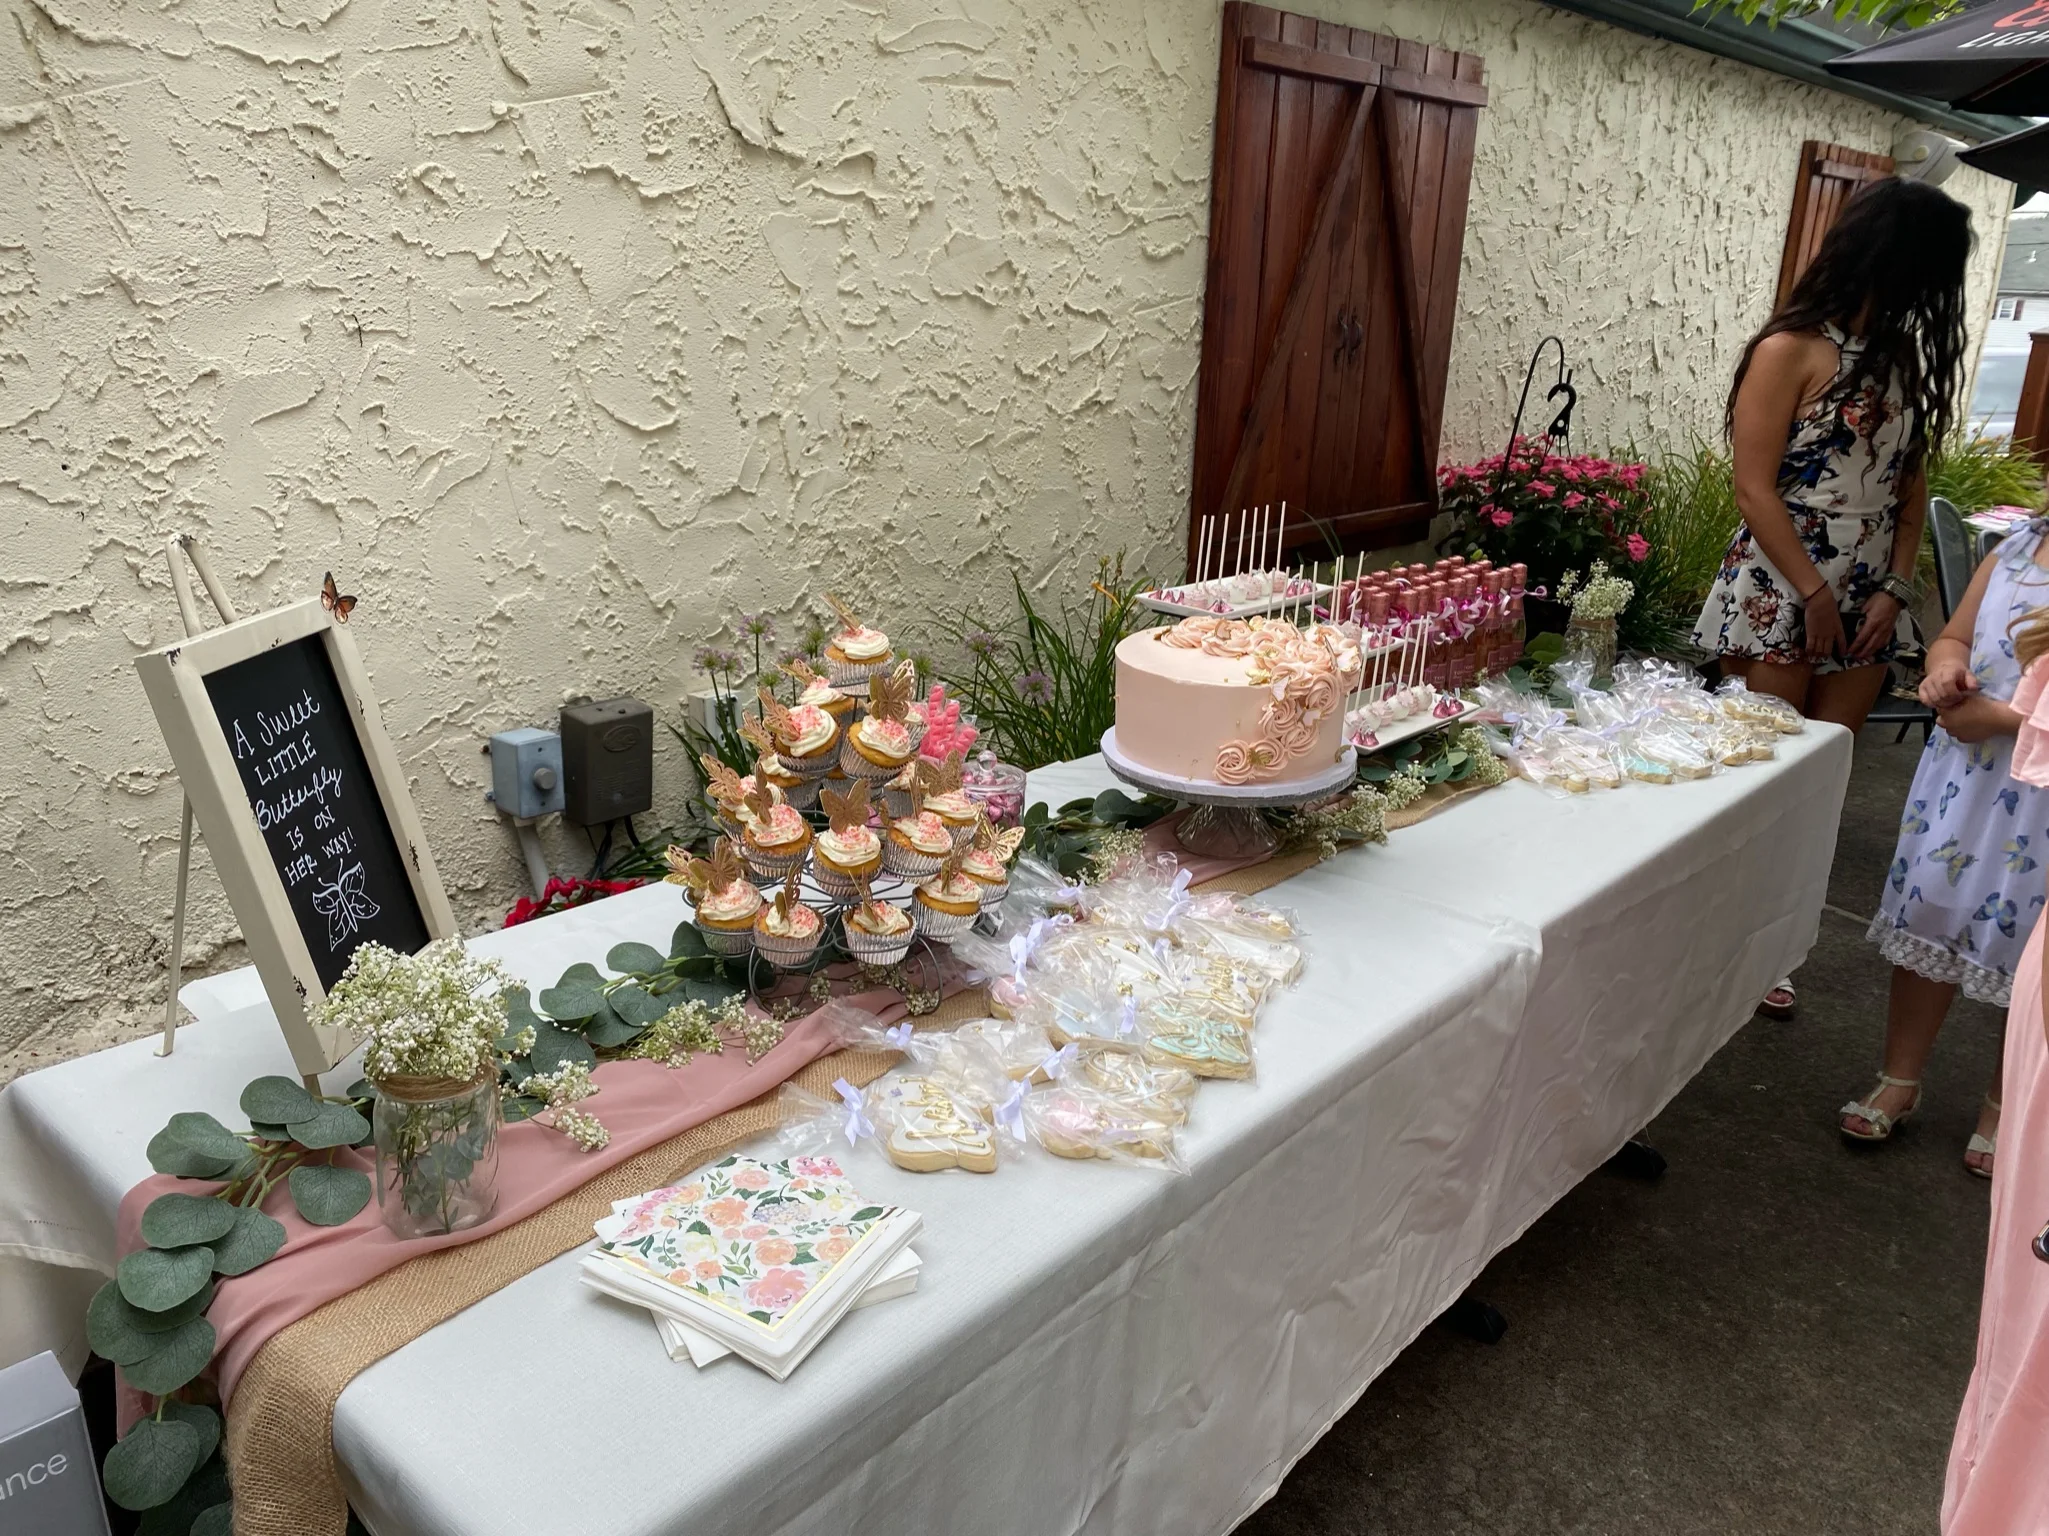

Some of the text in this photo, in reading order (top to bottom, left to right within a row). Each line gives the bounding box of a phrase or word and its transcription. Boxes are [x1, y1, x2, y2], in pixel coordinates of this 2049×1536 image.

[1957, 30, 2049, 48] LIGH
[233, 689, 320, 759] A Sweet
[254, 731, 318, 786] LITTLE
[255, 766, 342, 831] Butterfly
[284, 826, 357, 886] HER WAY!
[286, 804, 335, 851] IS ON
